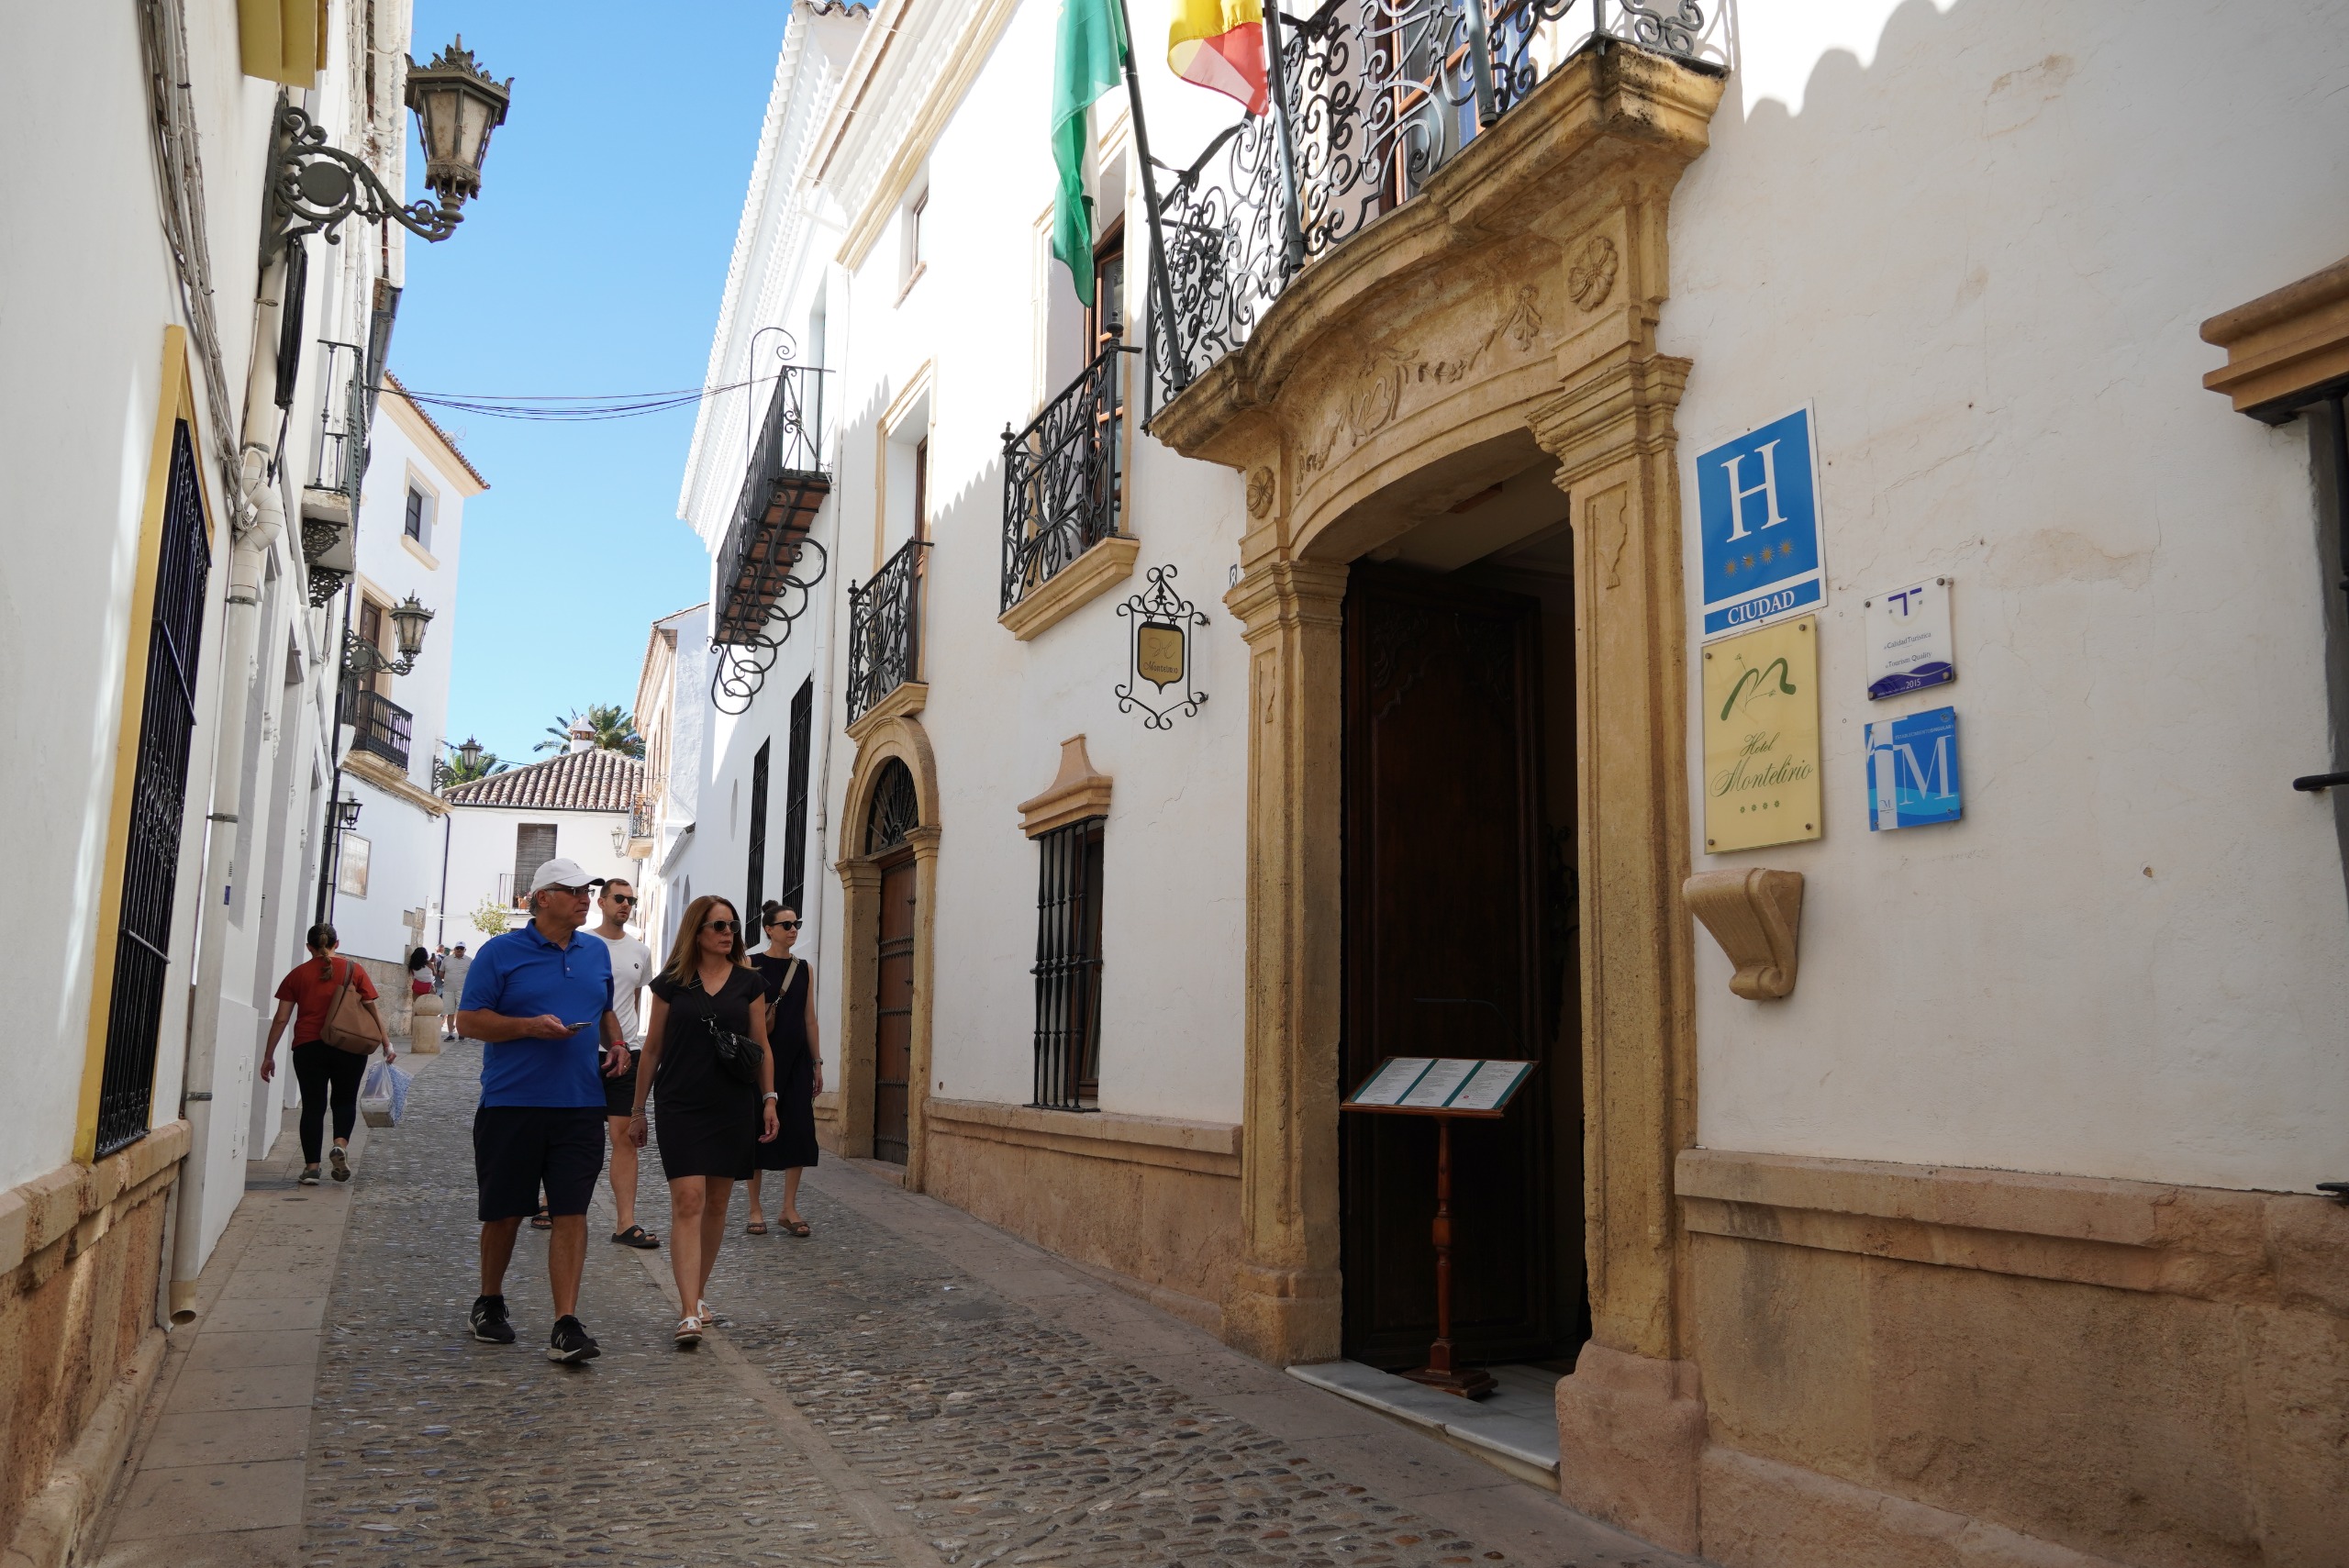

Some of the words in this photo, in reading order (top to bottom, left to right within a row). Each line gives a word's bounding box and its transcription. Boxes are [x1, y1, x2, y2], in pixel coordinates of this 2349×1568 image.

[1720, 439, 1788, 543] H
[1727, 590, 1795, 625] CIUDAD
[1888, 657, 1910, 668] Tourism
[1911, 651, 1932, 662] Quality
[1905, 678, 1921, 689] 2015
[1740, 731, 1780, 757] Hotel
[1710, 754, 1814, 797] Montelirio
